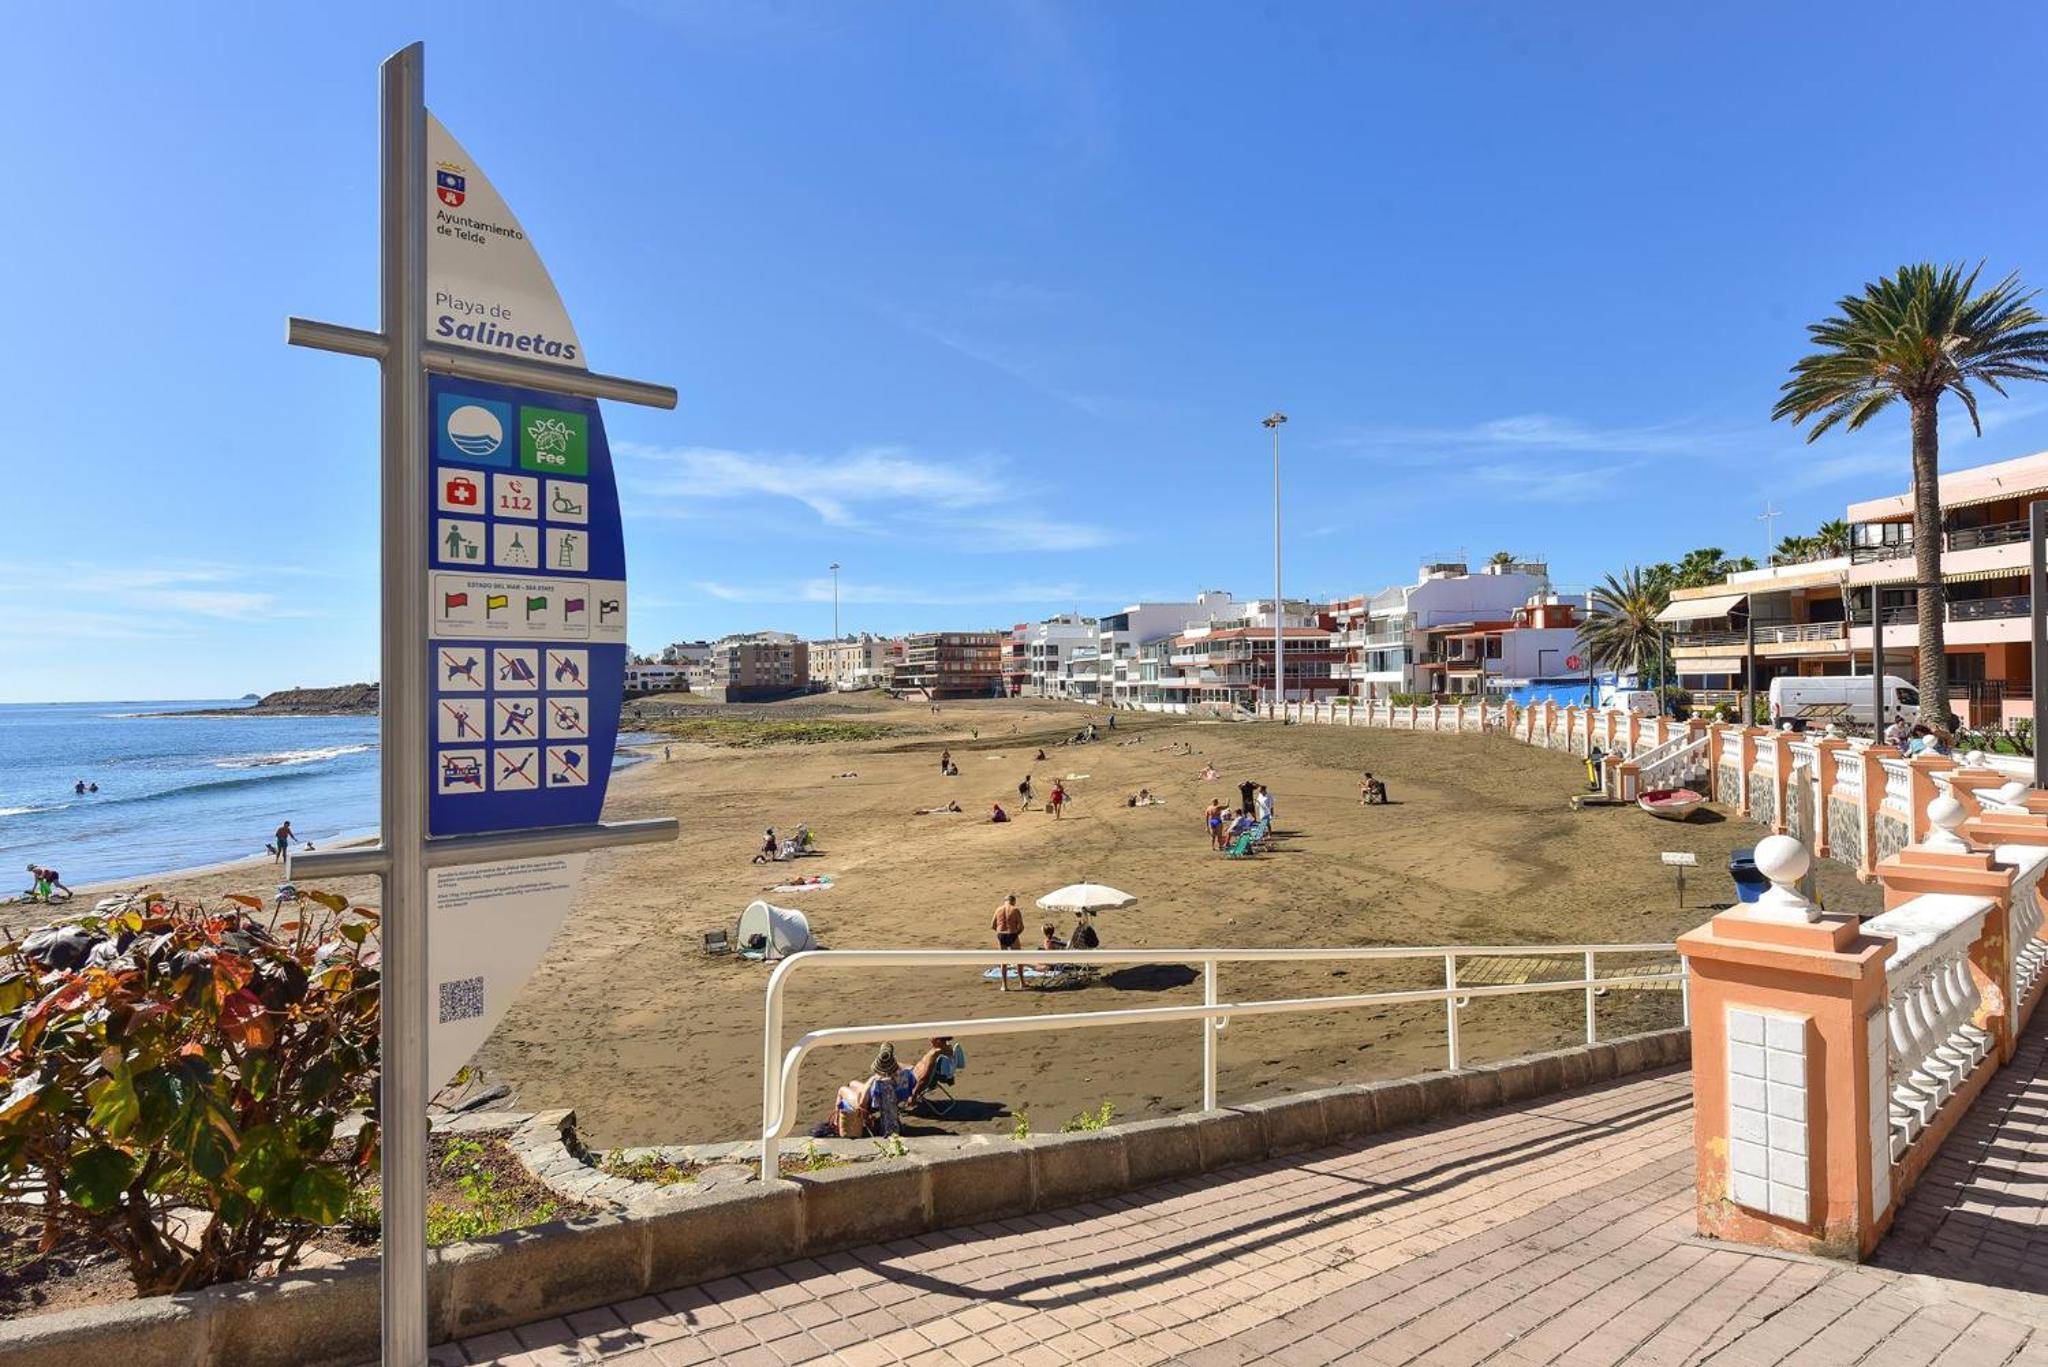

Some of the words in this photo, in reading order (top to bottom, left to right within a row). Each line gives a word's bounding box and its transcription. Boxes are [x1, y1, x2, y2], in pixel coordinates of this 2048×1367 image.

[437, 210, 523, 240] Ayuntamiento
[437, 224, 452, 237] de
[454, 227, 486, 244] Telde
[436, 292, 485, 315] Playa
[490, 304, 512, 320] de
[436, 315, 577, 360] Salinetas
[501, 495, 532, 511] 112
